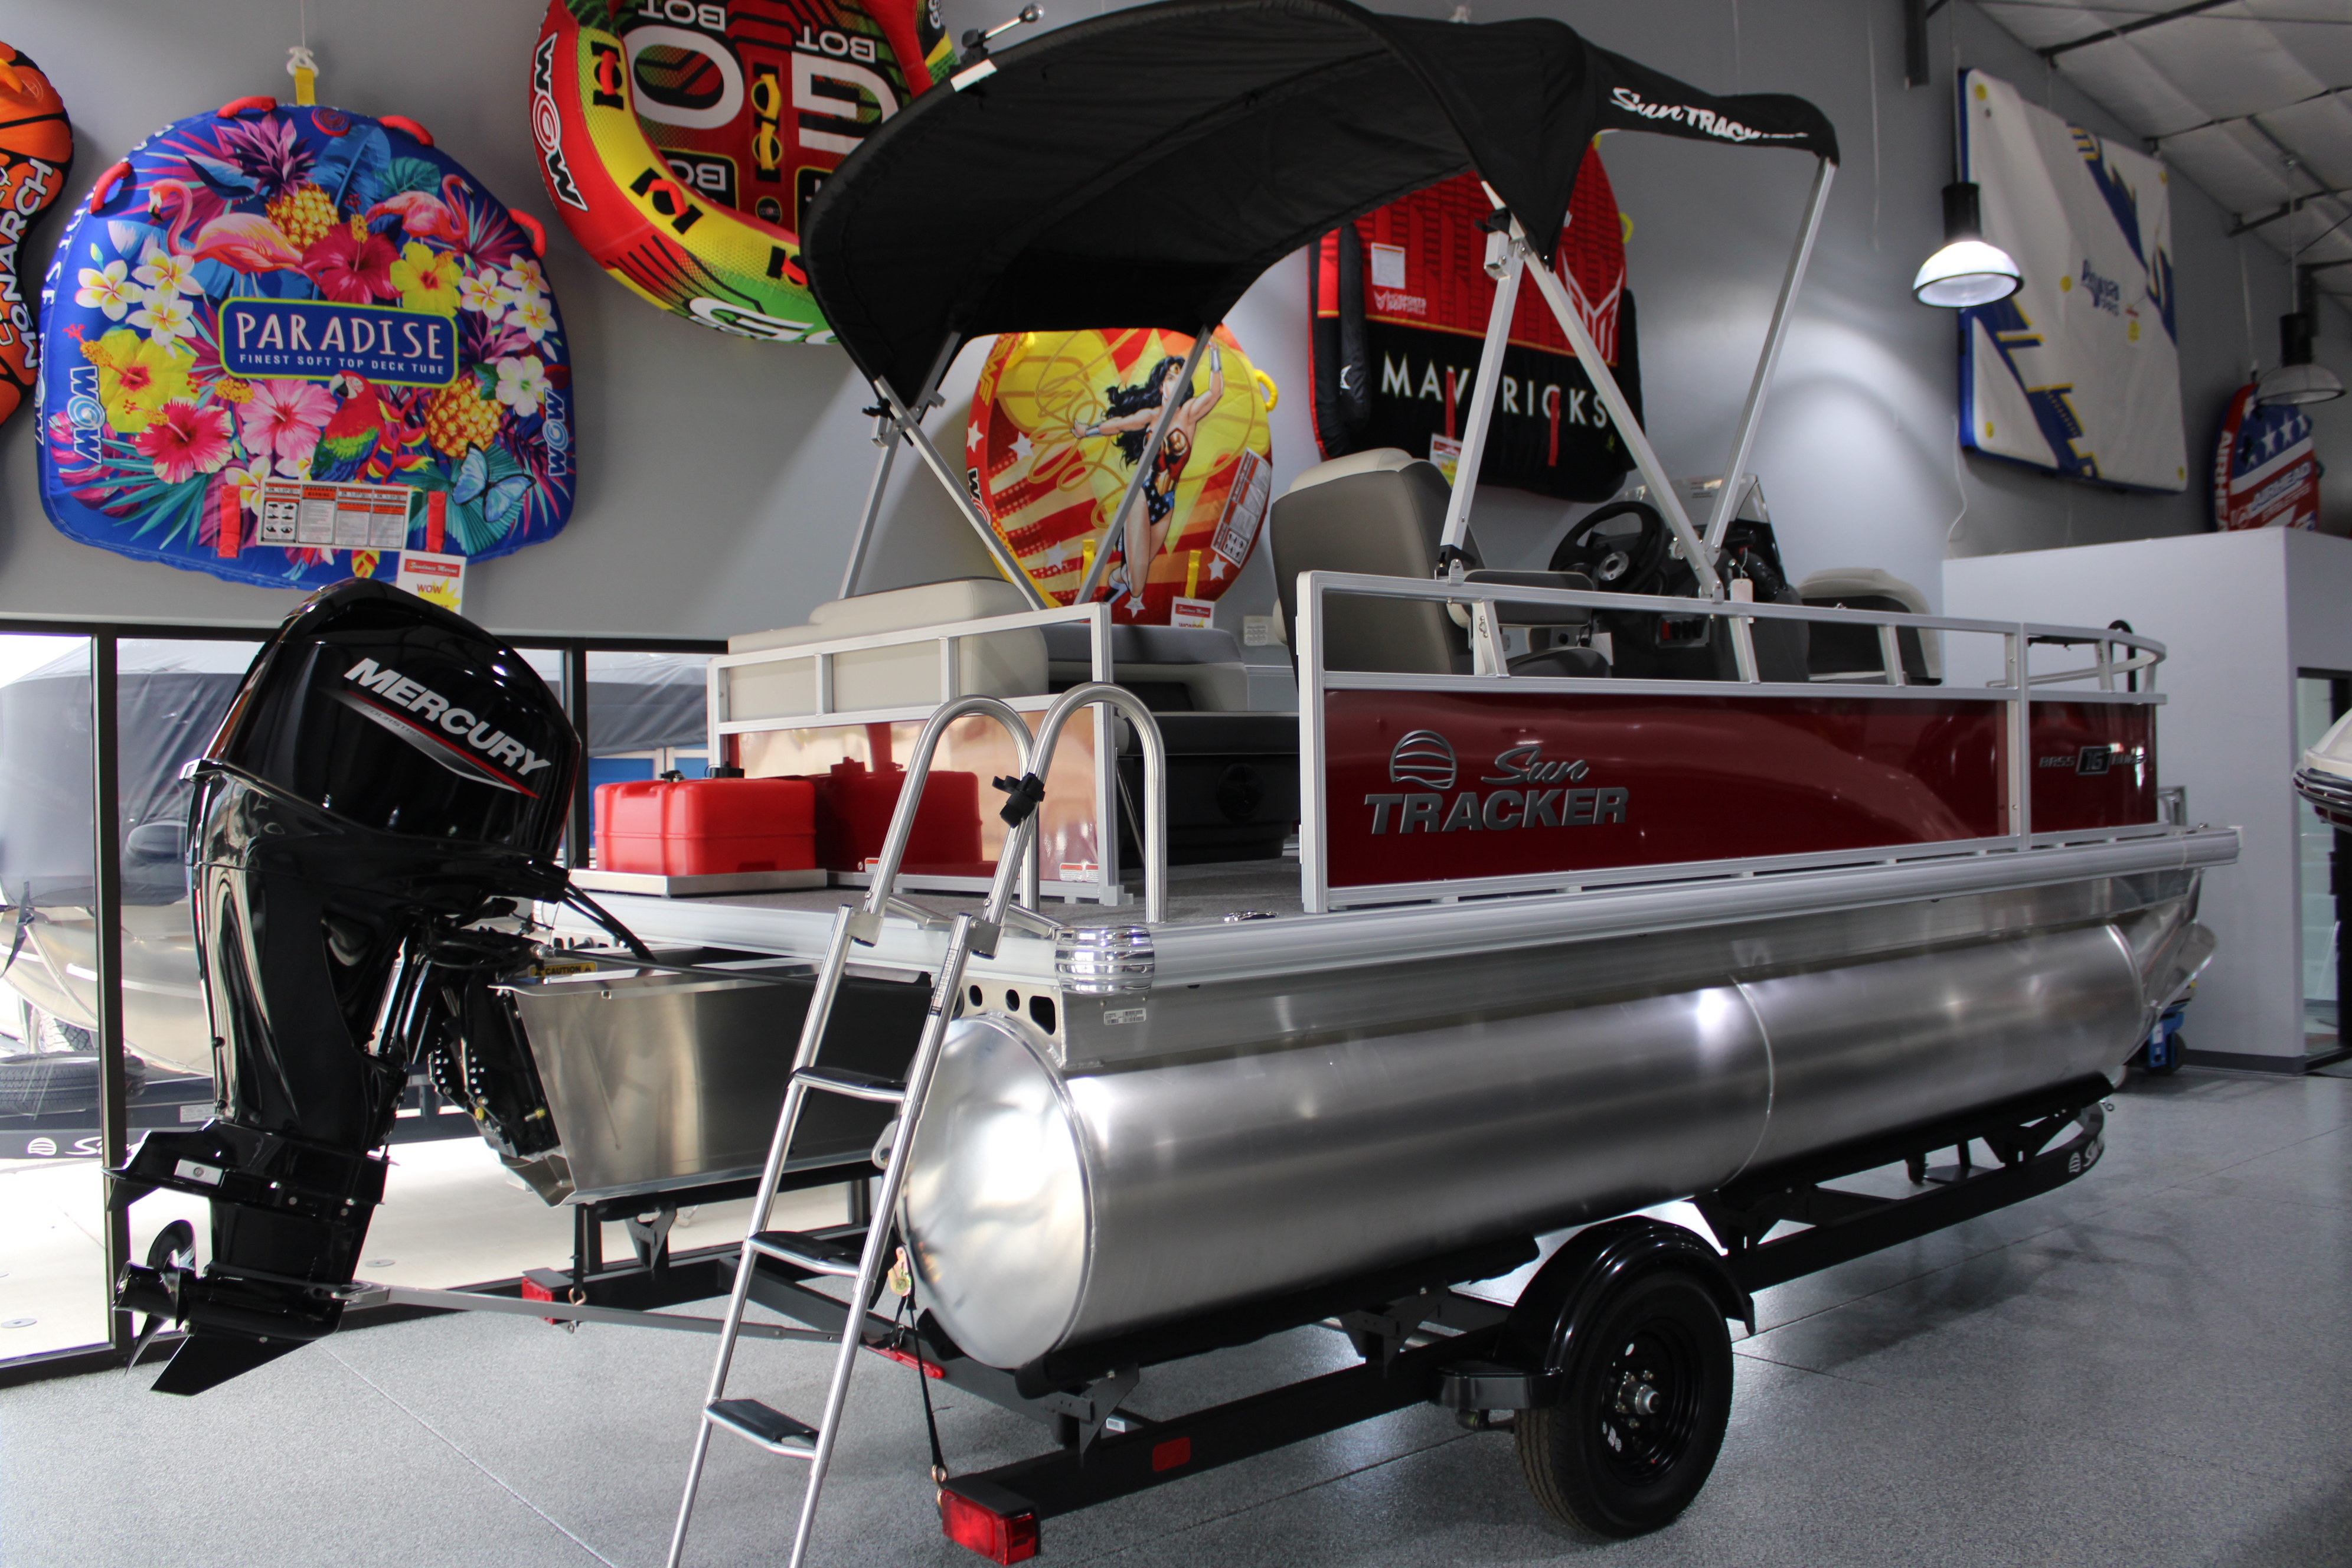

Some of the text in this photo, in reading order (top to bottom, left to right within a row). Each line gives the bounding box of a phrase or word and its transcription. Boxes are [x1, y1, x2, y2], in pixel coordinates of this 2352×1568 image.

[795, 25, 876, 63] BOT
[533, 31, 589, 211] WOW
[666, 159, 726, 191] BO
[0, 158, 54, 369] MONARCH
[236, 312, 445, 360] PARADISE
[239, 354, 444, 375] FINEST SOFT TOP DECK TUBE
[1381, 351, 1608, 429] MAVRICKS
[67, 365, 106, 465] WOW
[542, 387, 569, 477] WOW
[967, 467, 991, 527] WO
[417, 583, 443, 594] WOW
[343, 657, 551, 776] MERCURY
[1481, 745, 1590, 786] Sun
[2039, 756, 2076, 769] BASS
[1364, 786, 1629, 835] TRACKER
[545, 965, 582, 975] CAUTION
